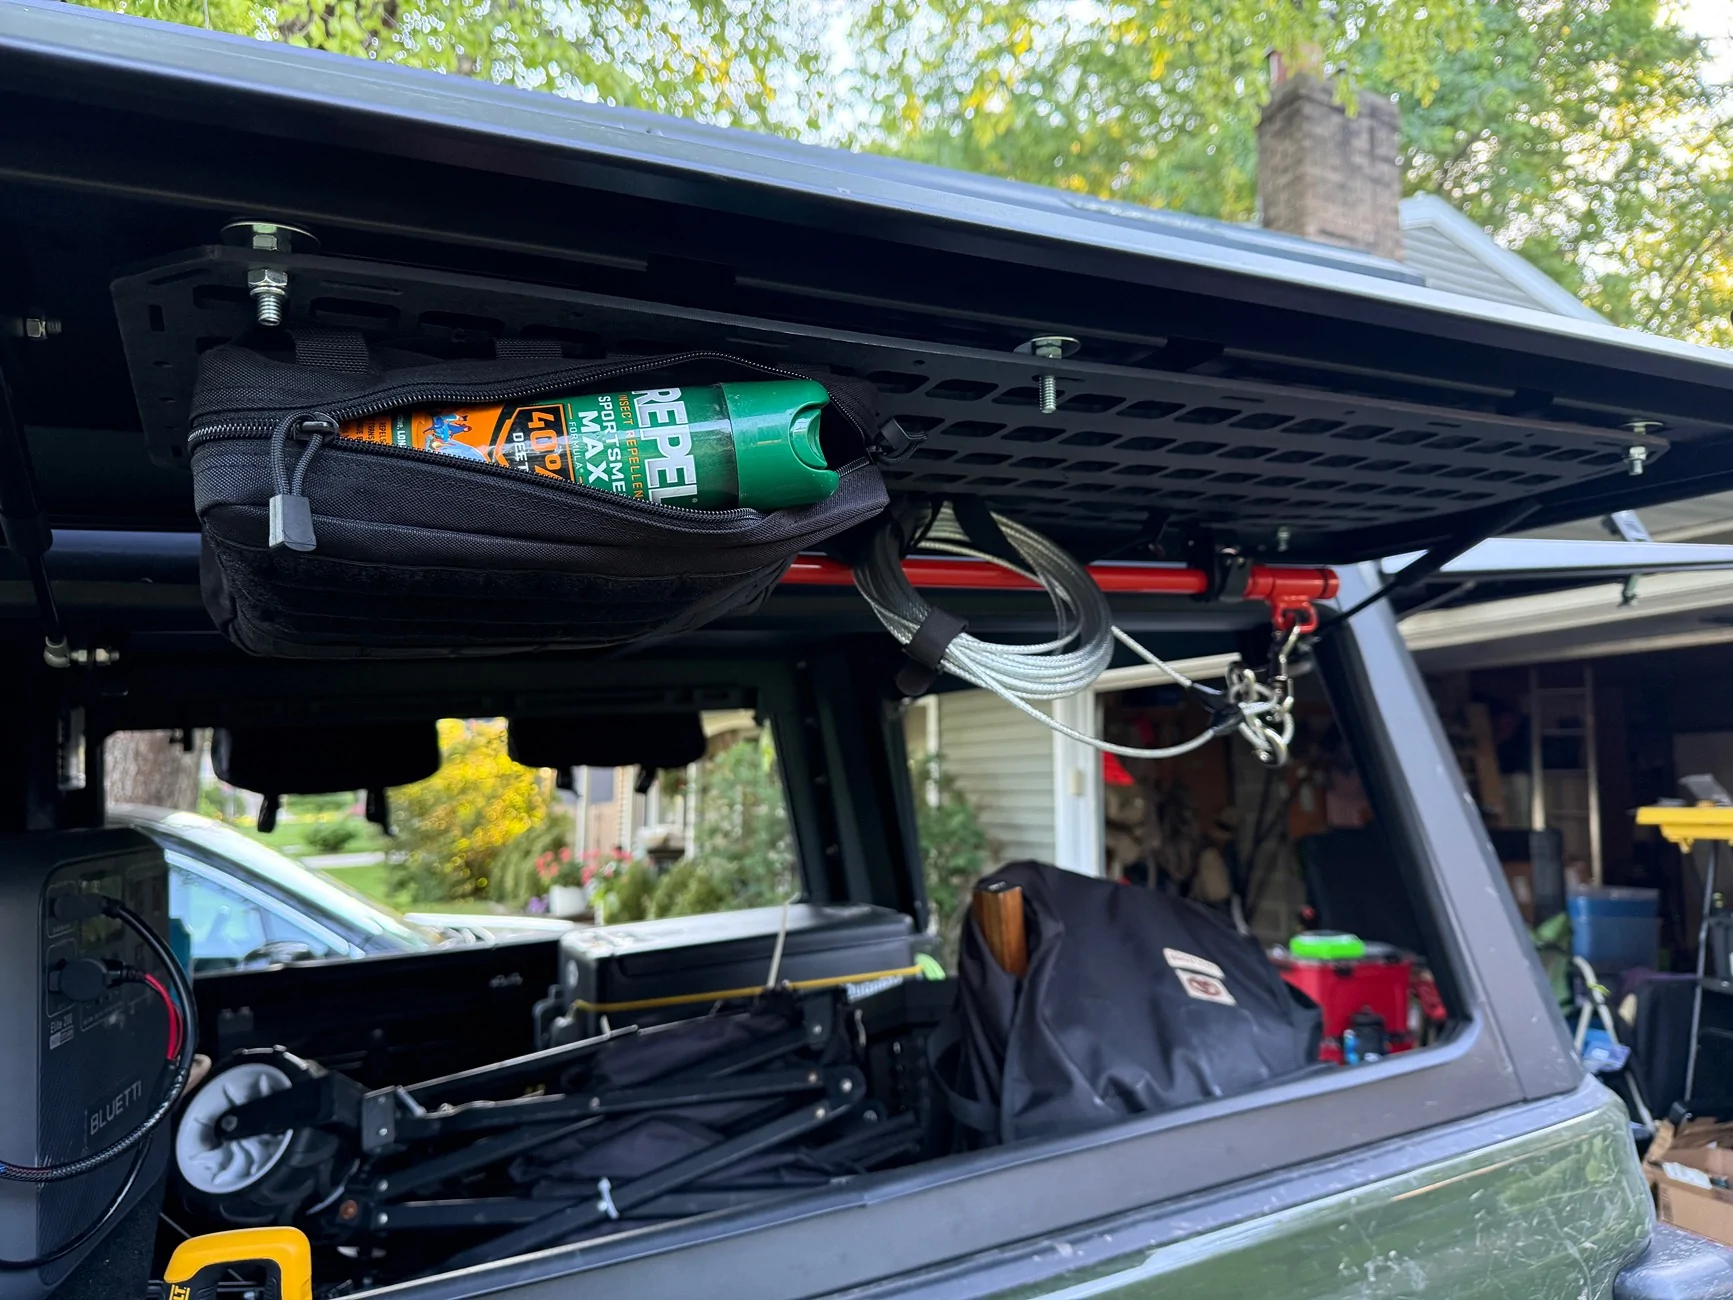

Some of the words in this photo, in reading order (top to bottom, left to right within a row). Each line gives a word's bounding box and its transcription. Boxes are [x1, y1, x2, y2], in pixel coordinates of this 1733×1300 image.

[396, 430, 408, 448] LON
[619, 394, 634, 425] INSECT
[513, 432, 529, 472] DEET
[578, 410, 609, 484] MAX
[598, 395, 627, 495] SPORTSME
[626, 430, 645, 500] REPELLEN
[632, 388, 698, 504] REPEL
[90, 1080, 142, 1136] BLUETTI
